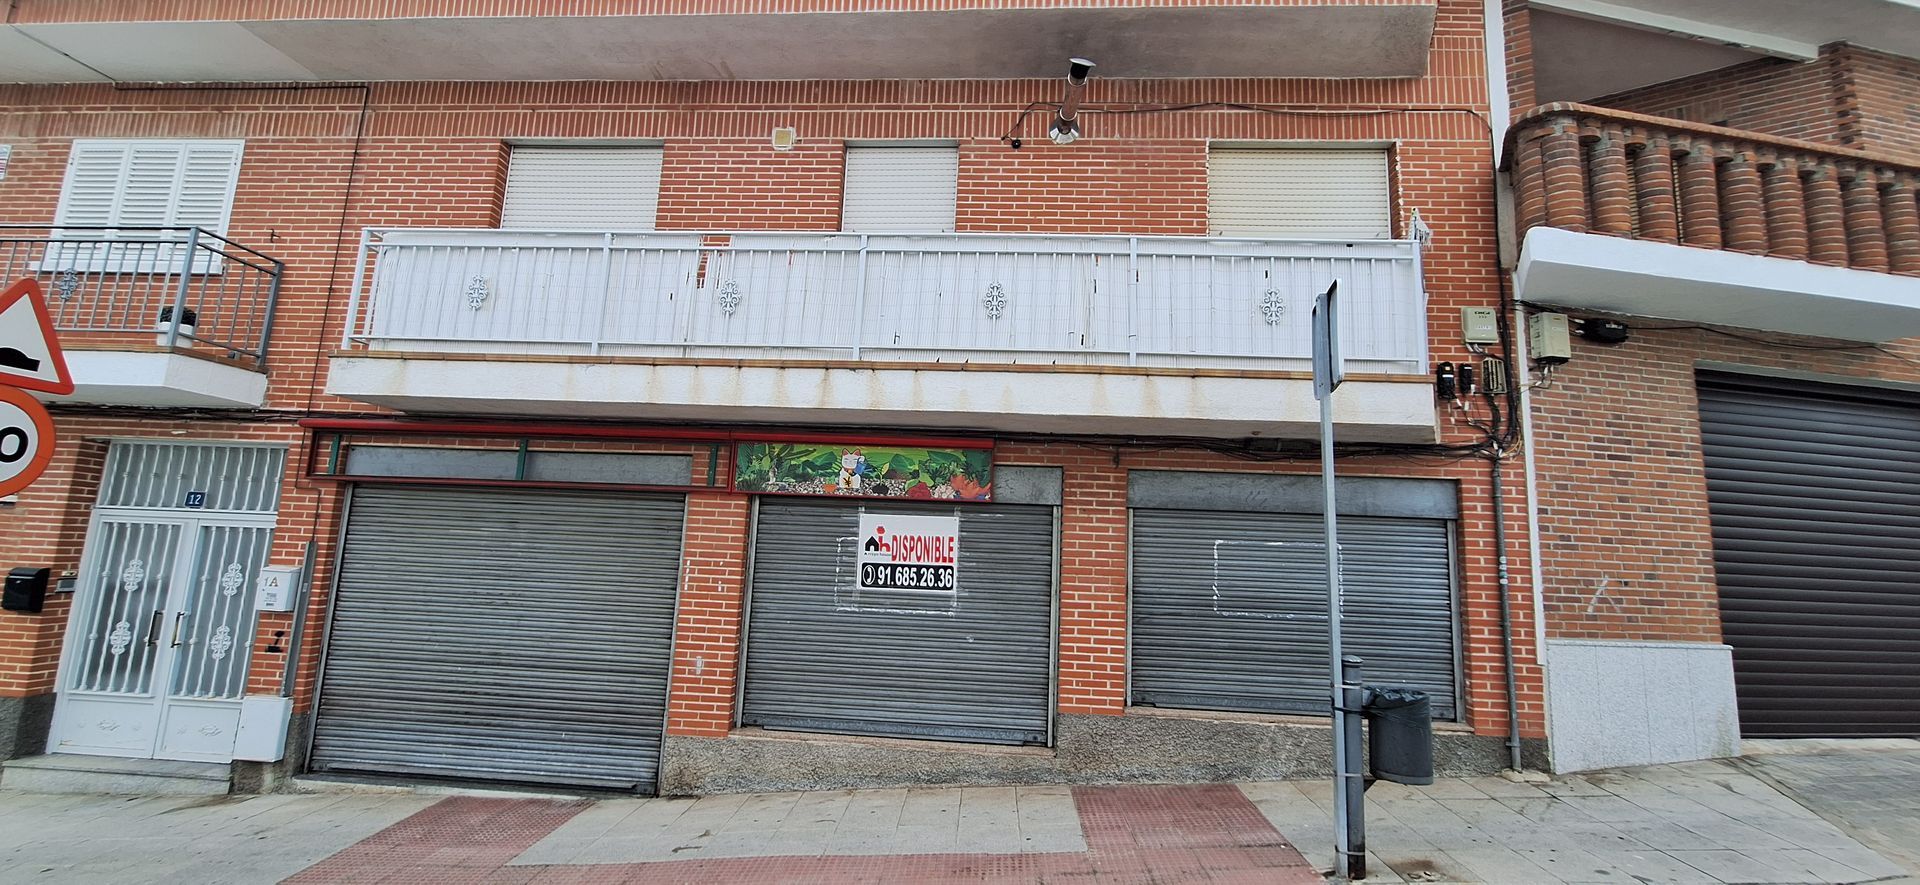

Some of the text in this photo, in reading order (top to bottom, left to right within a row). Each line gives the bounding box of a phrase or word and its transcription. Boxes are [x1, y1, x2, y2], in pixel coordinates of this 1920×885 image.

[189, 494, 202, 505] 12
[891, 534, 955, 563] DISPONIBLE
[877, 565, 953, 588] 91.685.26.36
